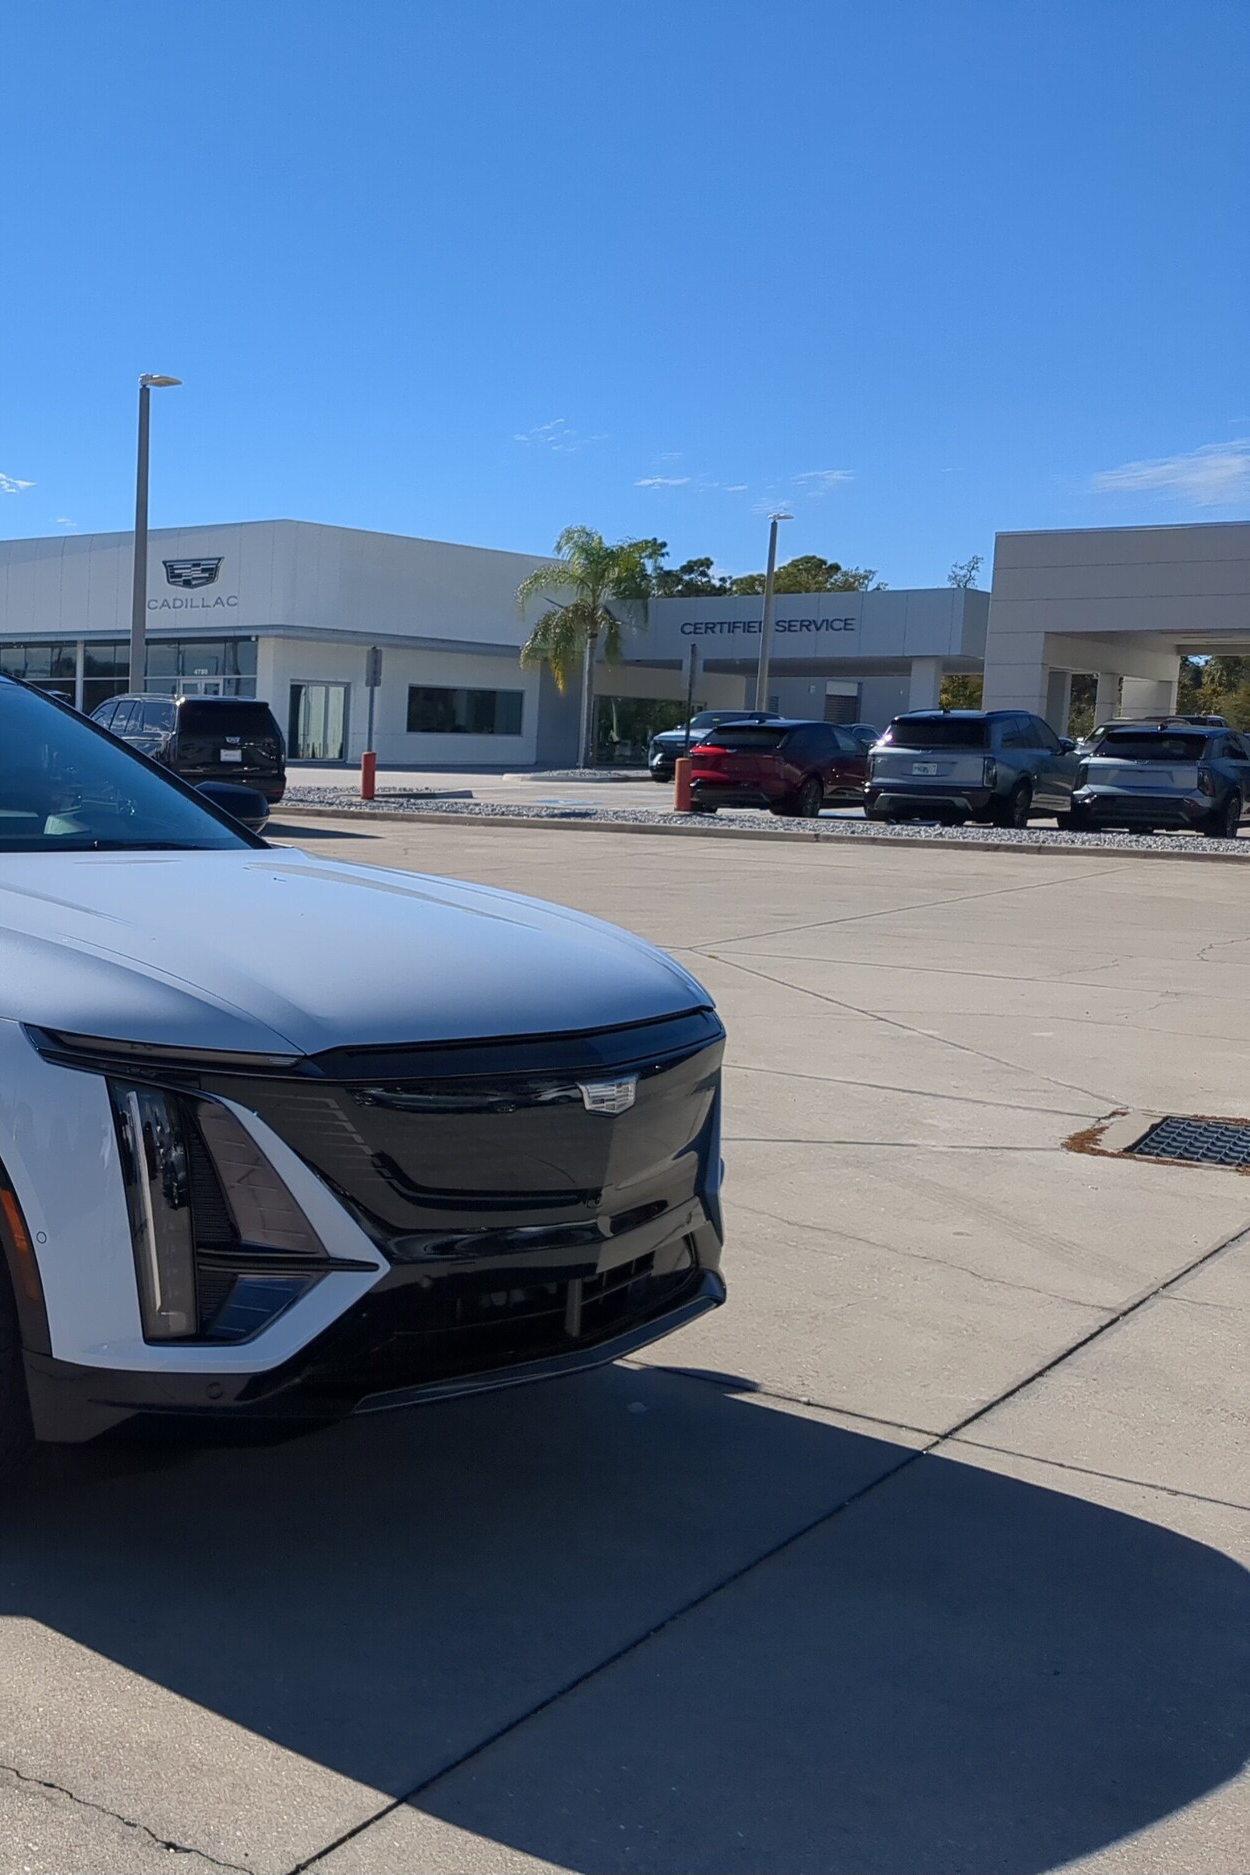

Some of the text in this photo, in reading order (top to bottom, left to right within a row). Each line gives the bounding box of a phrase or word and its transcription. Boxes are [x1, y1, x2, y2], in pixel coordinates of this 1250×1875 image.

[147, 595, 238, 610] CADILLAC
[680, 618, 856, 635] CERTIFIE SERVICE
